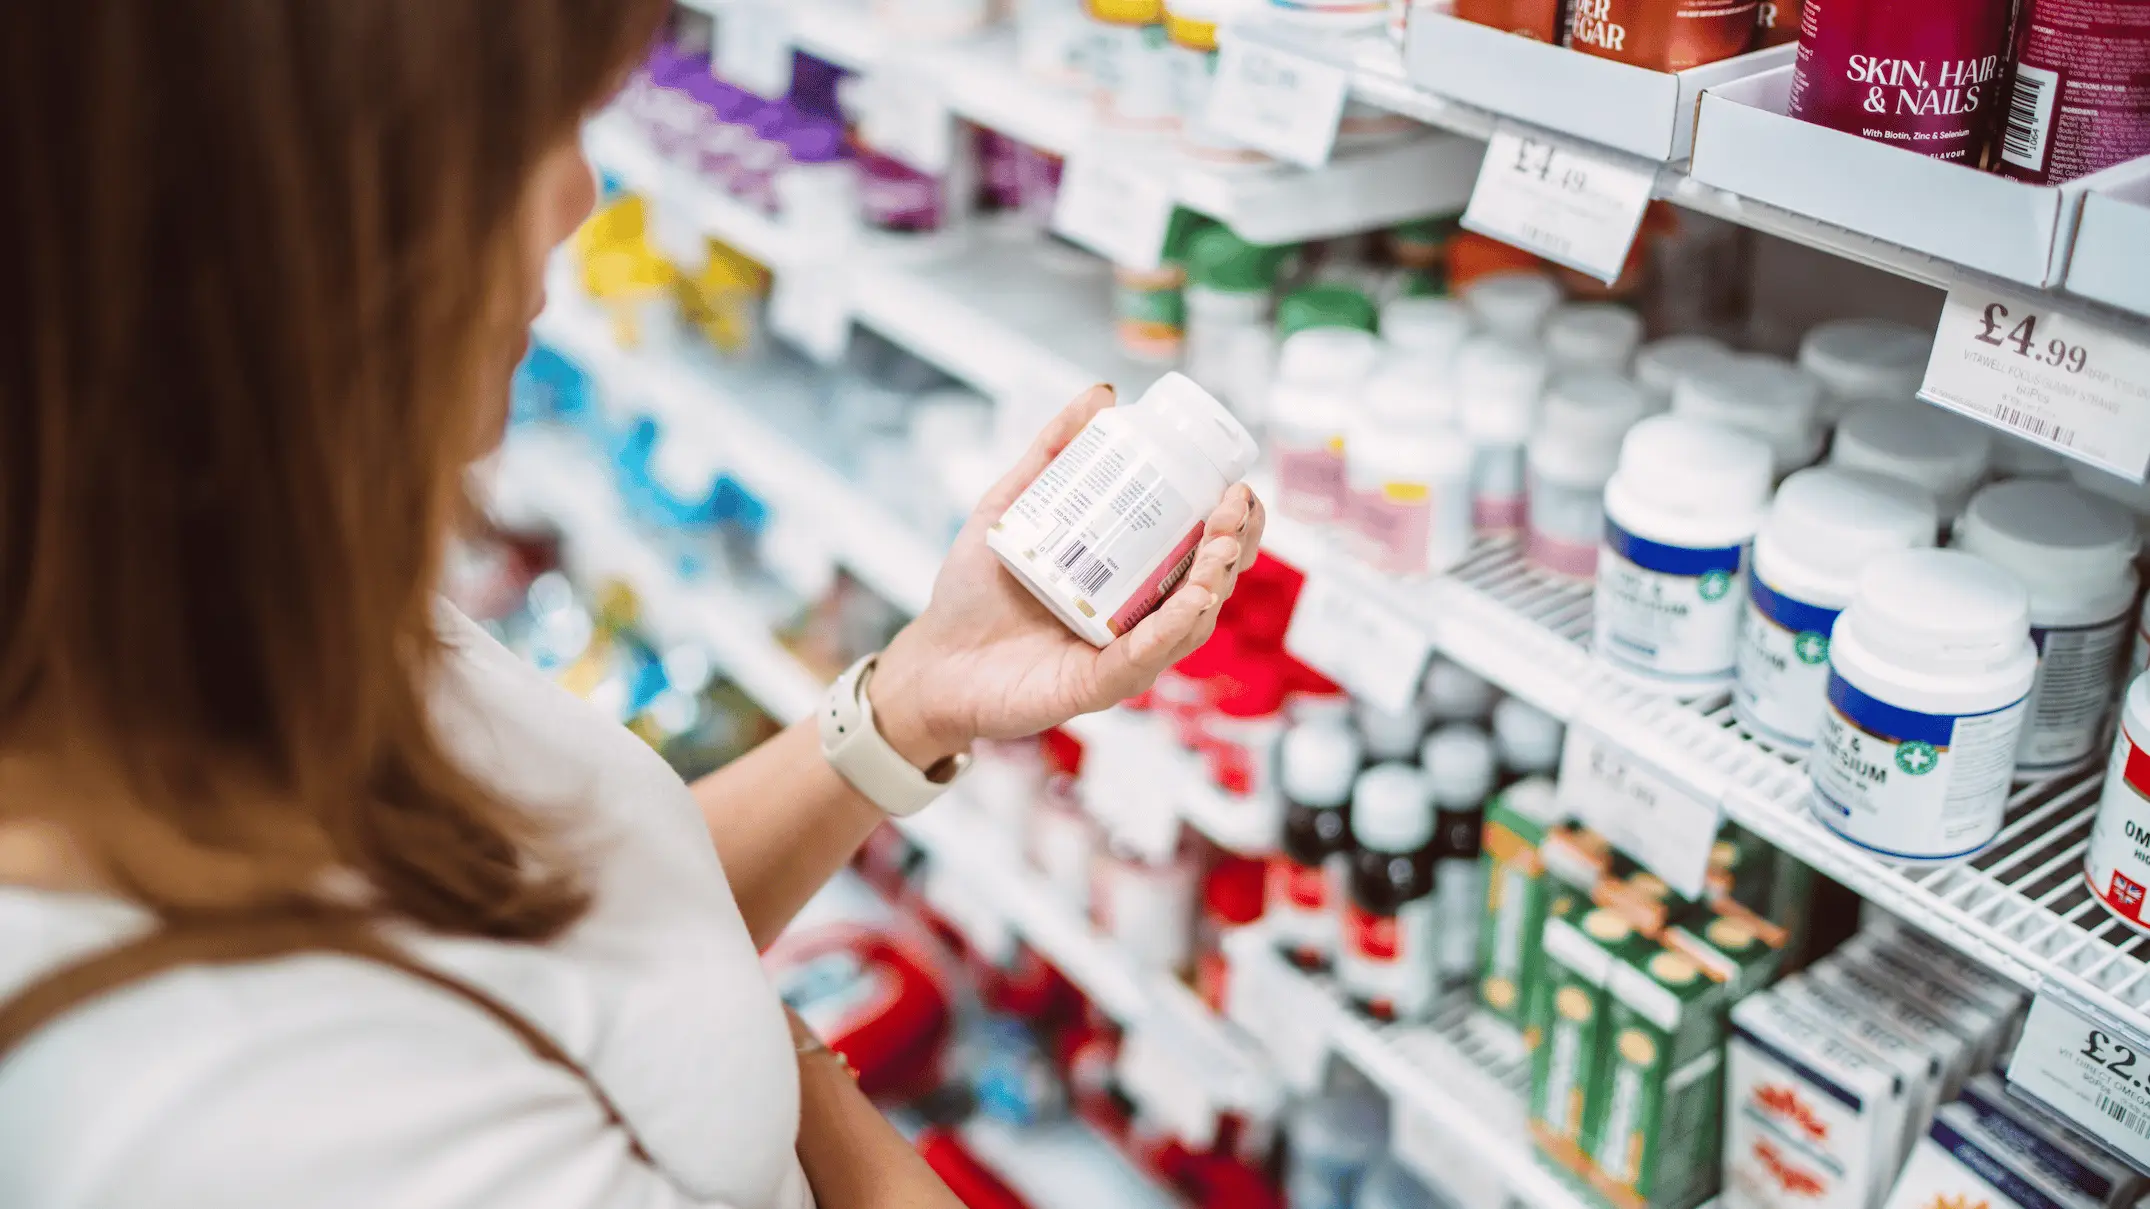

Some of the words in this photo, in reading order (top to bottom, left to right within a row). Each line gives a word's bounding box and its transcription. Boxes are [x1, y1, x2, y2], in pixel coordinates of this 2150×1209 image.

[1846, 54, 1930, 90] SKIN,
[1938, 55, 1997, 87] HAIR
[2066, 80, 2100, 90] DIRECTIONS
[1863, 86, 1886, 113] &
[1895, 86, 1980, 116] NAILS
[1862, 128, 1883, 139] With
[1884, 129, 1911, 141] Biotin,
[1913, 131, 1930, 140] Zinc
[1932, 131, 1939, 140] &
[1940, 128, 1970, 140] Selenium
[1930, 149, 1966, 160] FLAVOUR
[1974, 302, 2087, 374] £4.99
[1963, 348, 2006, 374] VITAWELL
[2008, 365, 2041, 385] FOCUS
